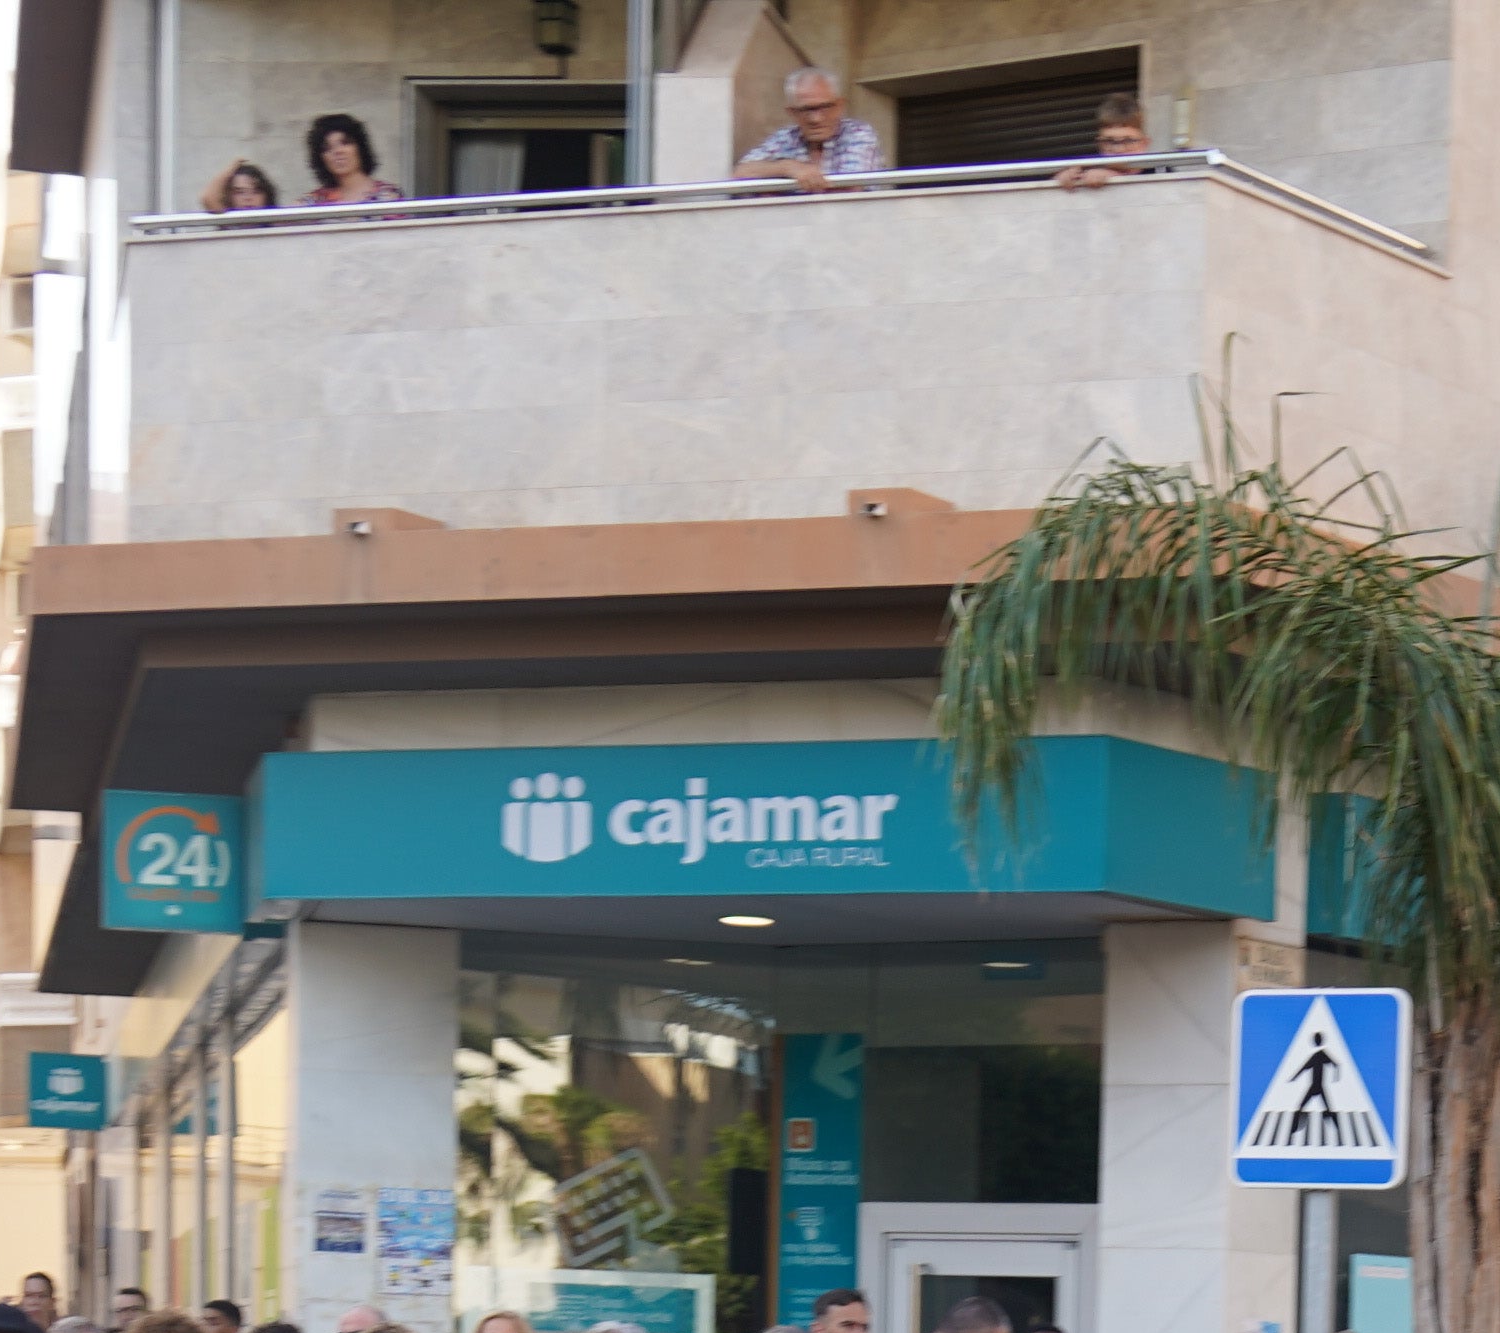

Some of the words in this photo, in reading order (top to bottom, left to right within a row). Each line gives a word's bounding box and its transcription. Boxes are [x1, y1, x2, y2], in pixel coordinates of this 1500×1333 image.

[607, 777, 900, 865] cajamar
[745, 847, 810, 868] CAJA
[812, 847, 892, 867] RURAL
